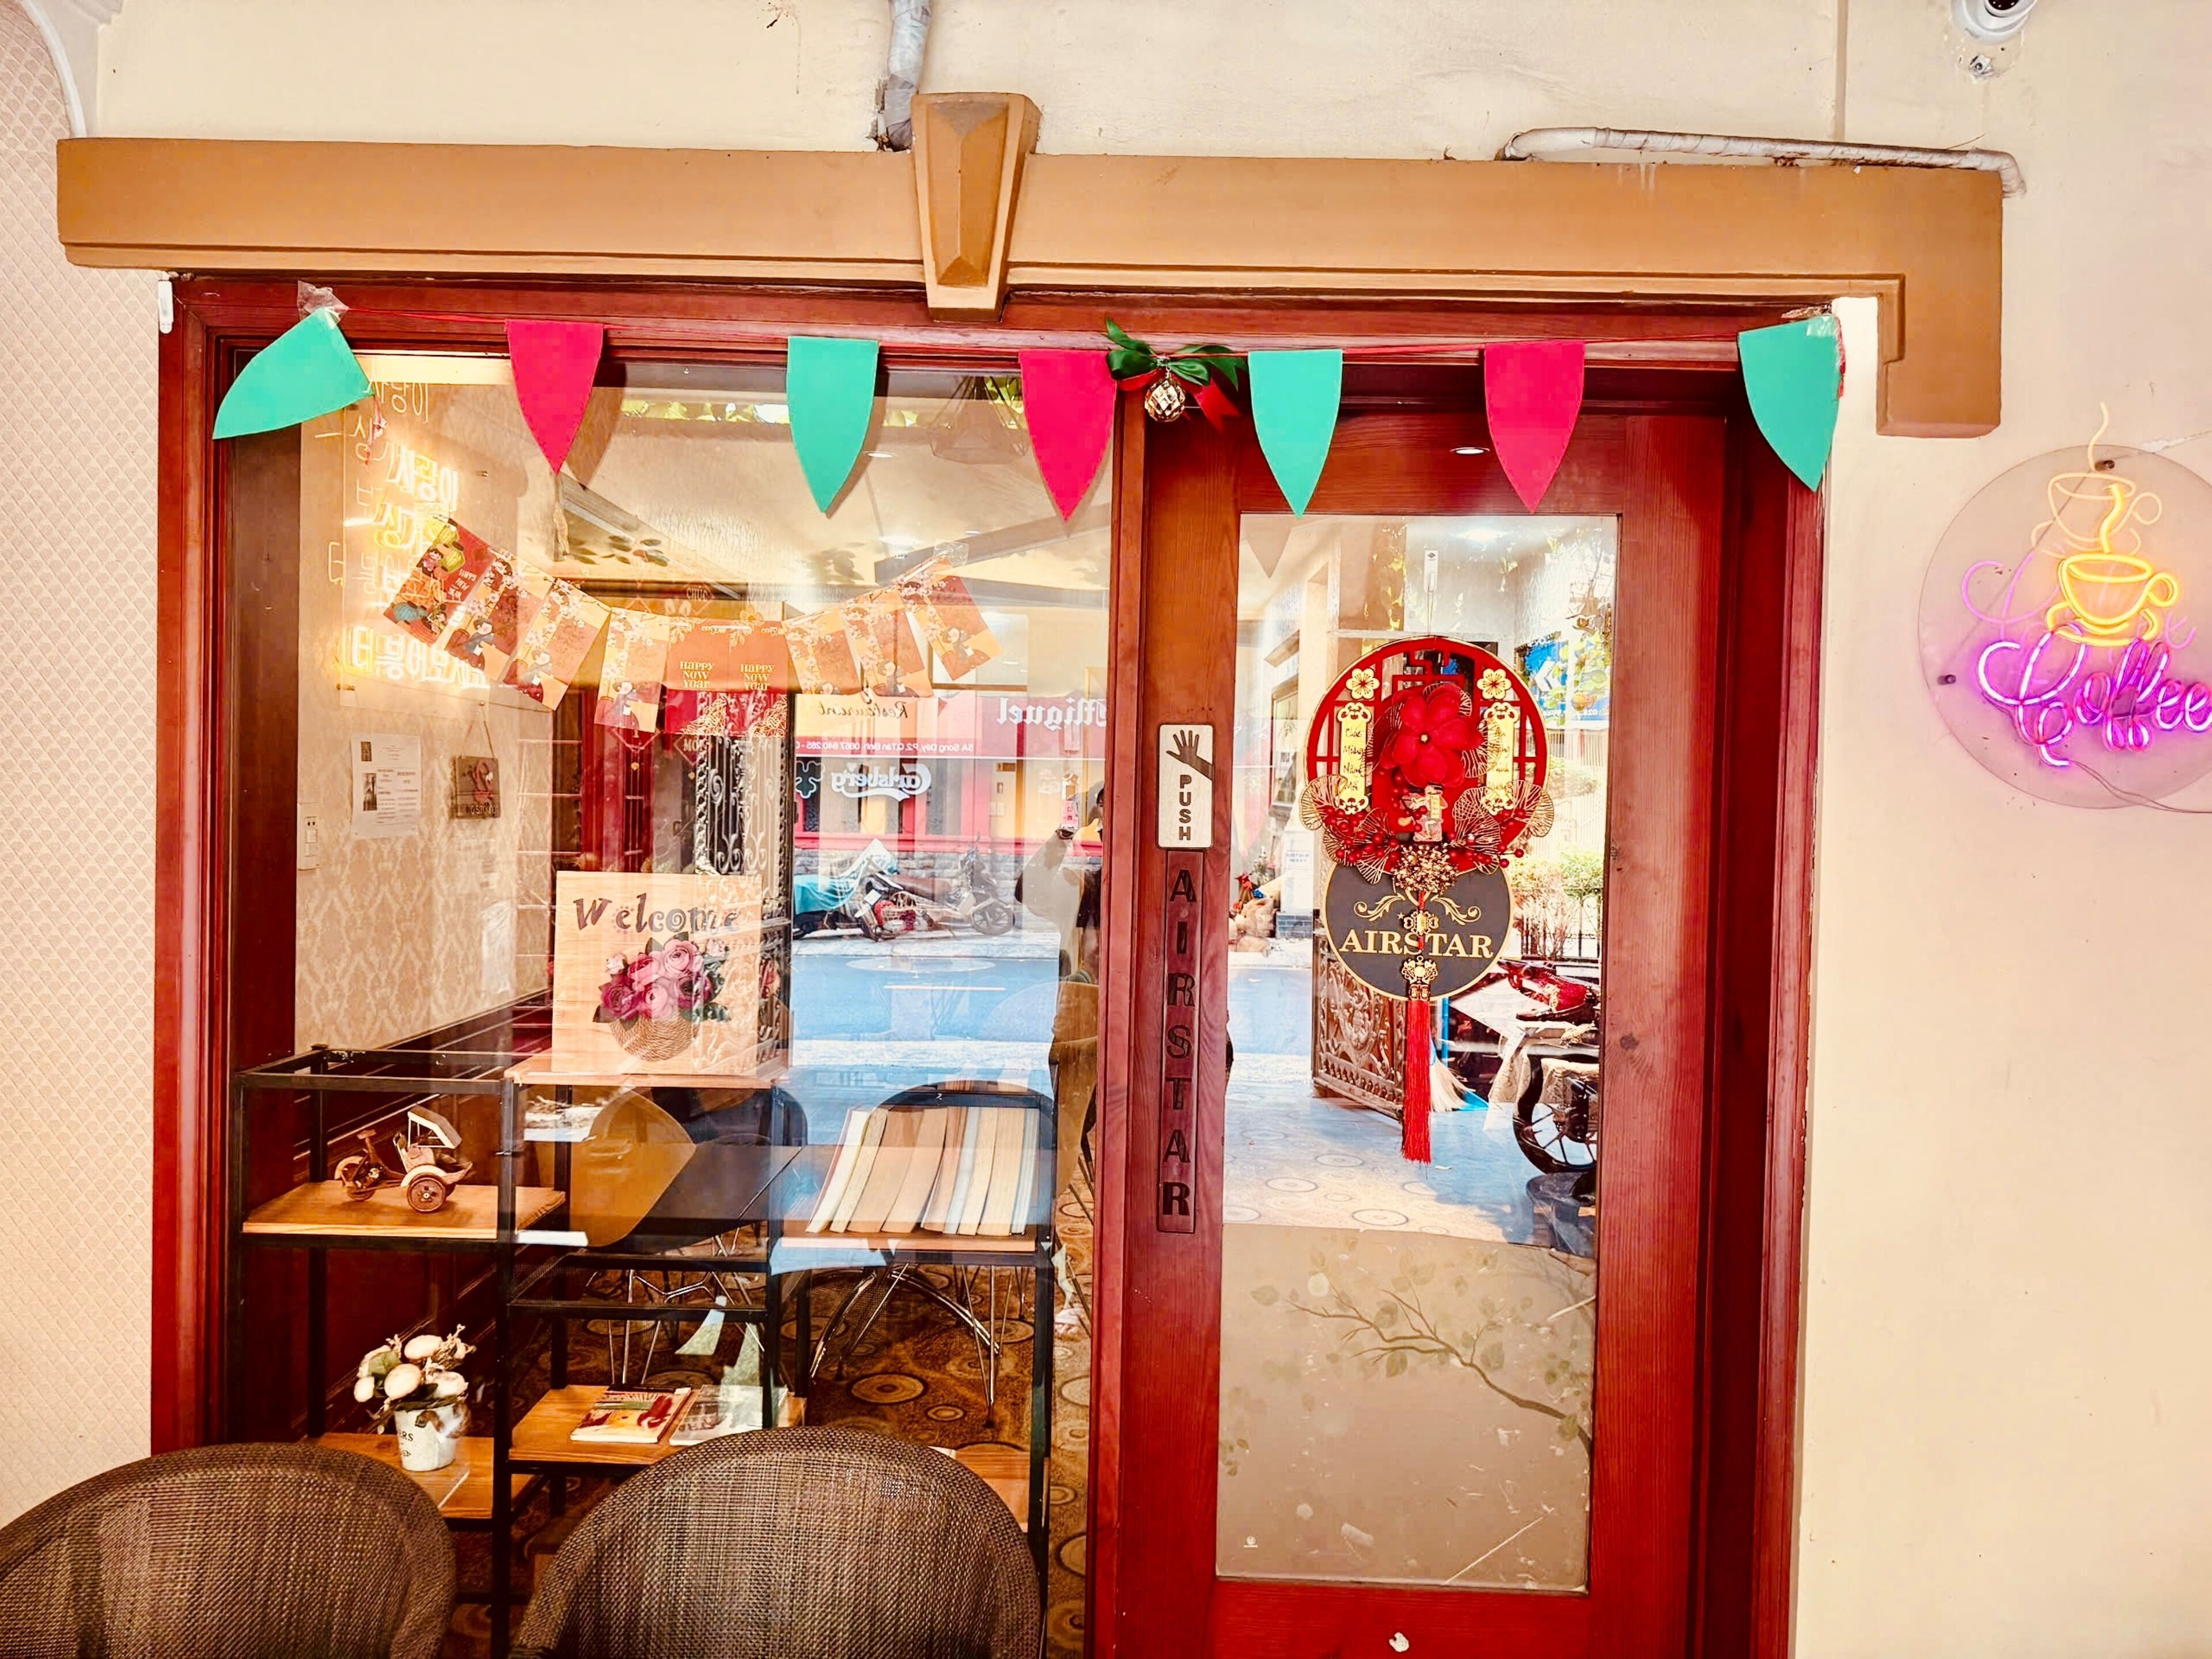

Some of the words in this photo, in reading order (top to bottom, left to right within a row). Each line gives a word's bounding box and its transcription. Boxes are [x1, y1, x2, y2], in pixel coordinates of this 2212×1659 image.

[1179, 774, 1192, 840] PUSH
[573, 892, 742, 934] Welcome
[1339, 929, 1494, 959] AIRSTAR
[1161, 868, 1197, 1216] AIRSTAR
